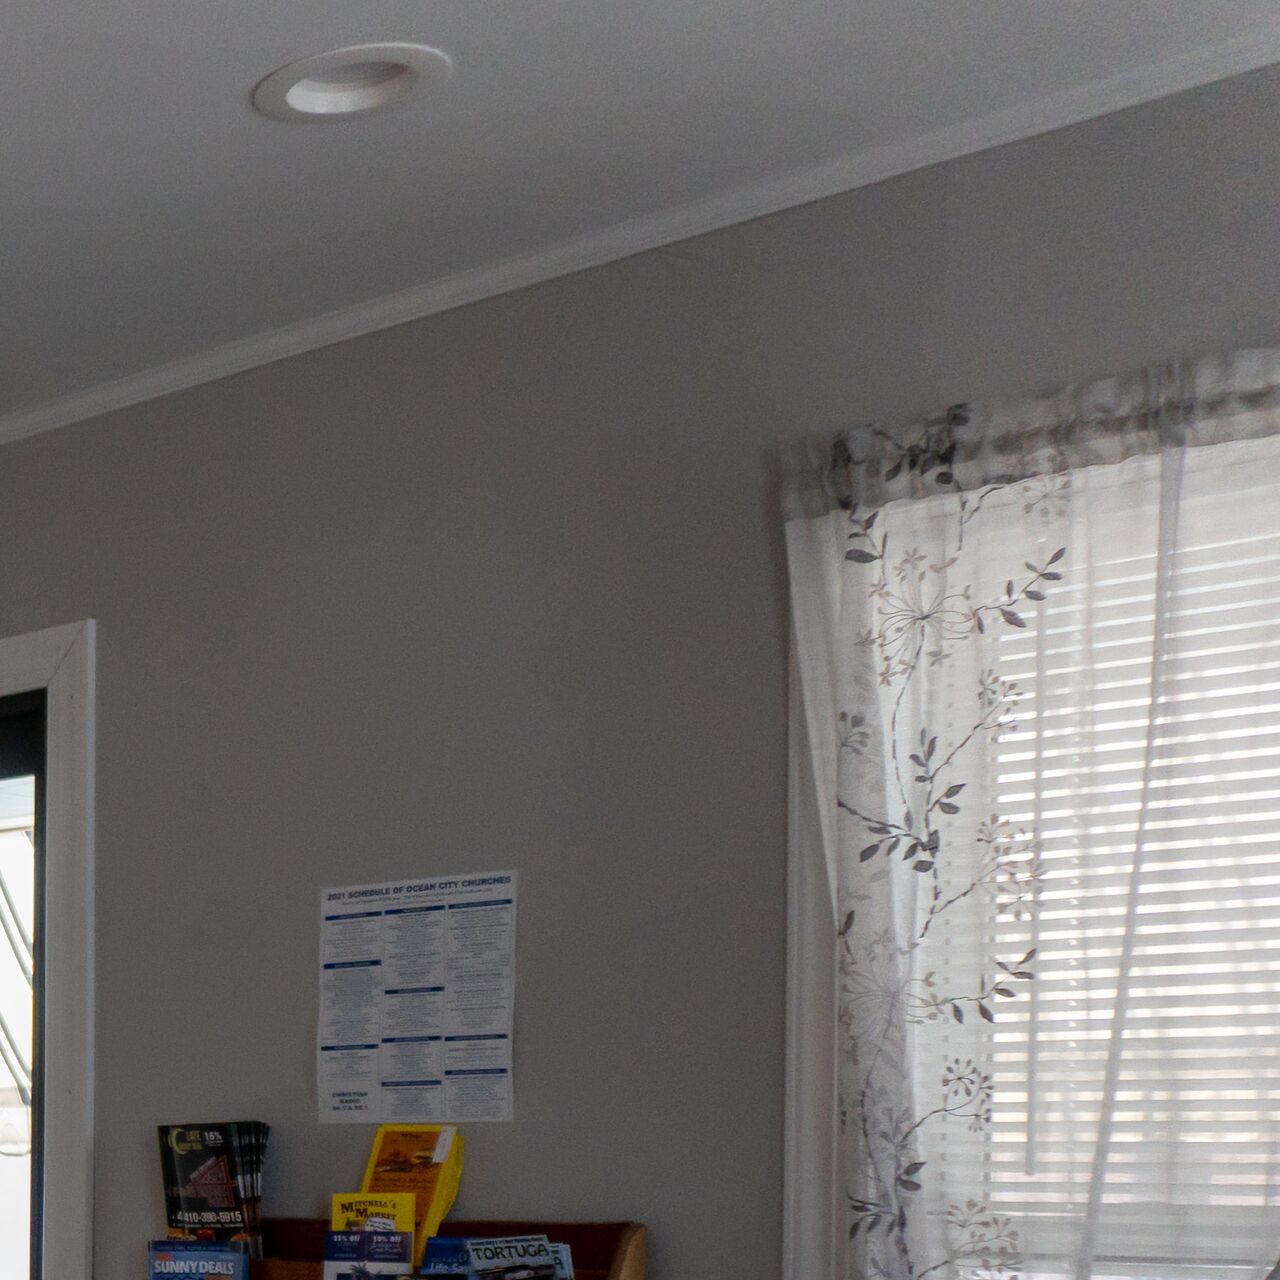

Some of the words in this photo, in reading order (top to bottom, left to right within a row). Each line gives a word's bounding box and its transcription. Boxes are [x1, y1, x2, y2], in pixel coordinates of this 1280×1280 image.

[347, 888, 391, 899] SCHEDULE
[392, 885, 404, 894] OF
[406, 882, 437, 894] OCEAN
[438, 880, 459, 891] CITY
[461, 875, 512, 888] CHURCHES
[472, 1243, 550, 1261] TORTUGA
[153, 1260, 198, 1274] SUNNY
[200, 1261, 234, 1275] DEALS
